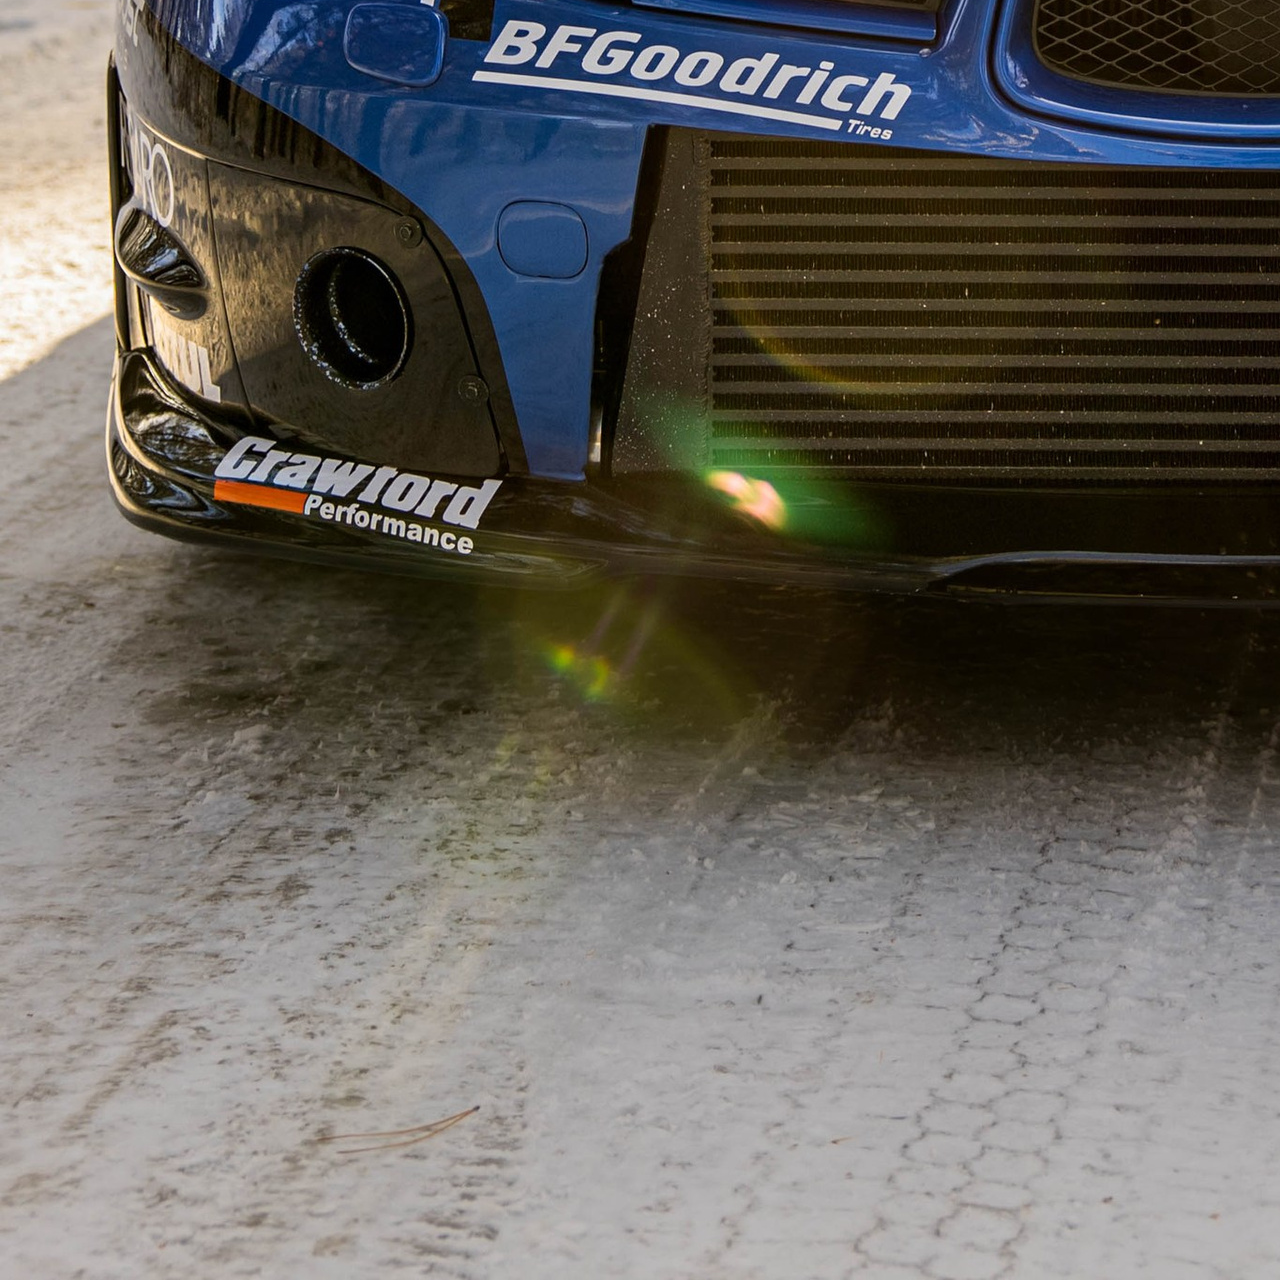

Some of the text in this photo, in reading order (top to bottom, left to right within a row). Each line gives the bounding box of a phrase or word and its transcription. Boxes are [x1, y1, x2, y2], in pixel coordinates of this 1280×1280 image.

[484, 20, 912, 121] BFGoodrich
[845, 118, 894, 141] Tires
[214, 436, 503, 530] Crawford
[304, 494, 474, 555] Performance
